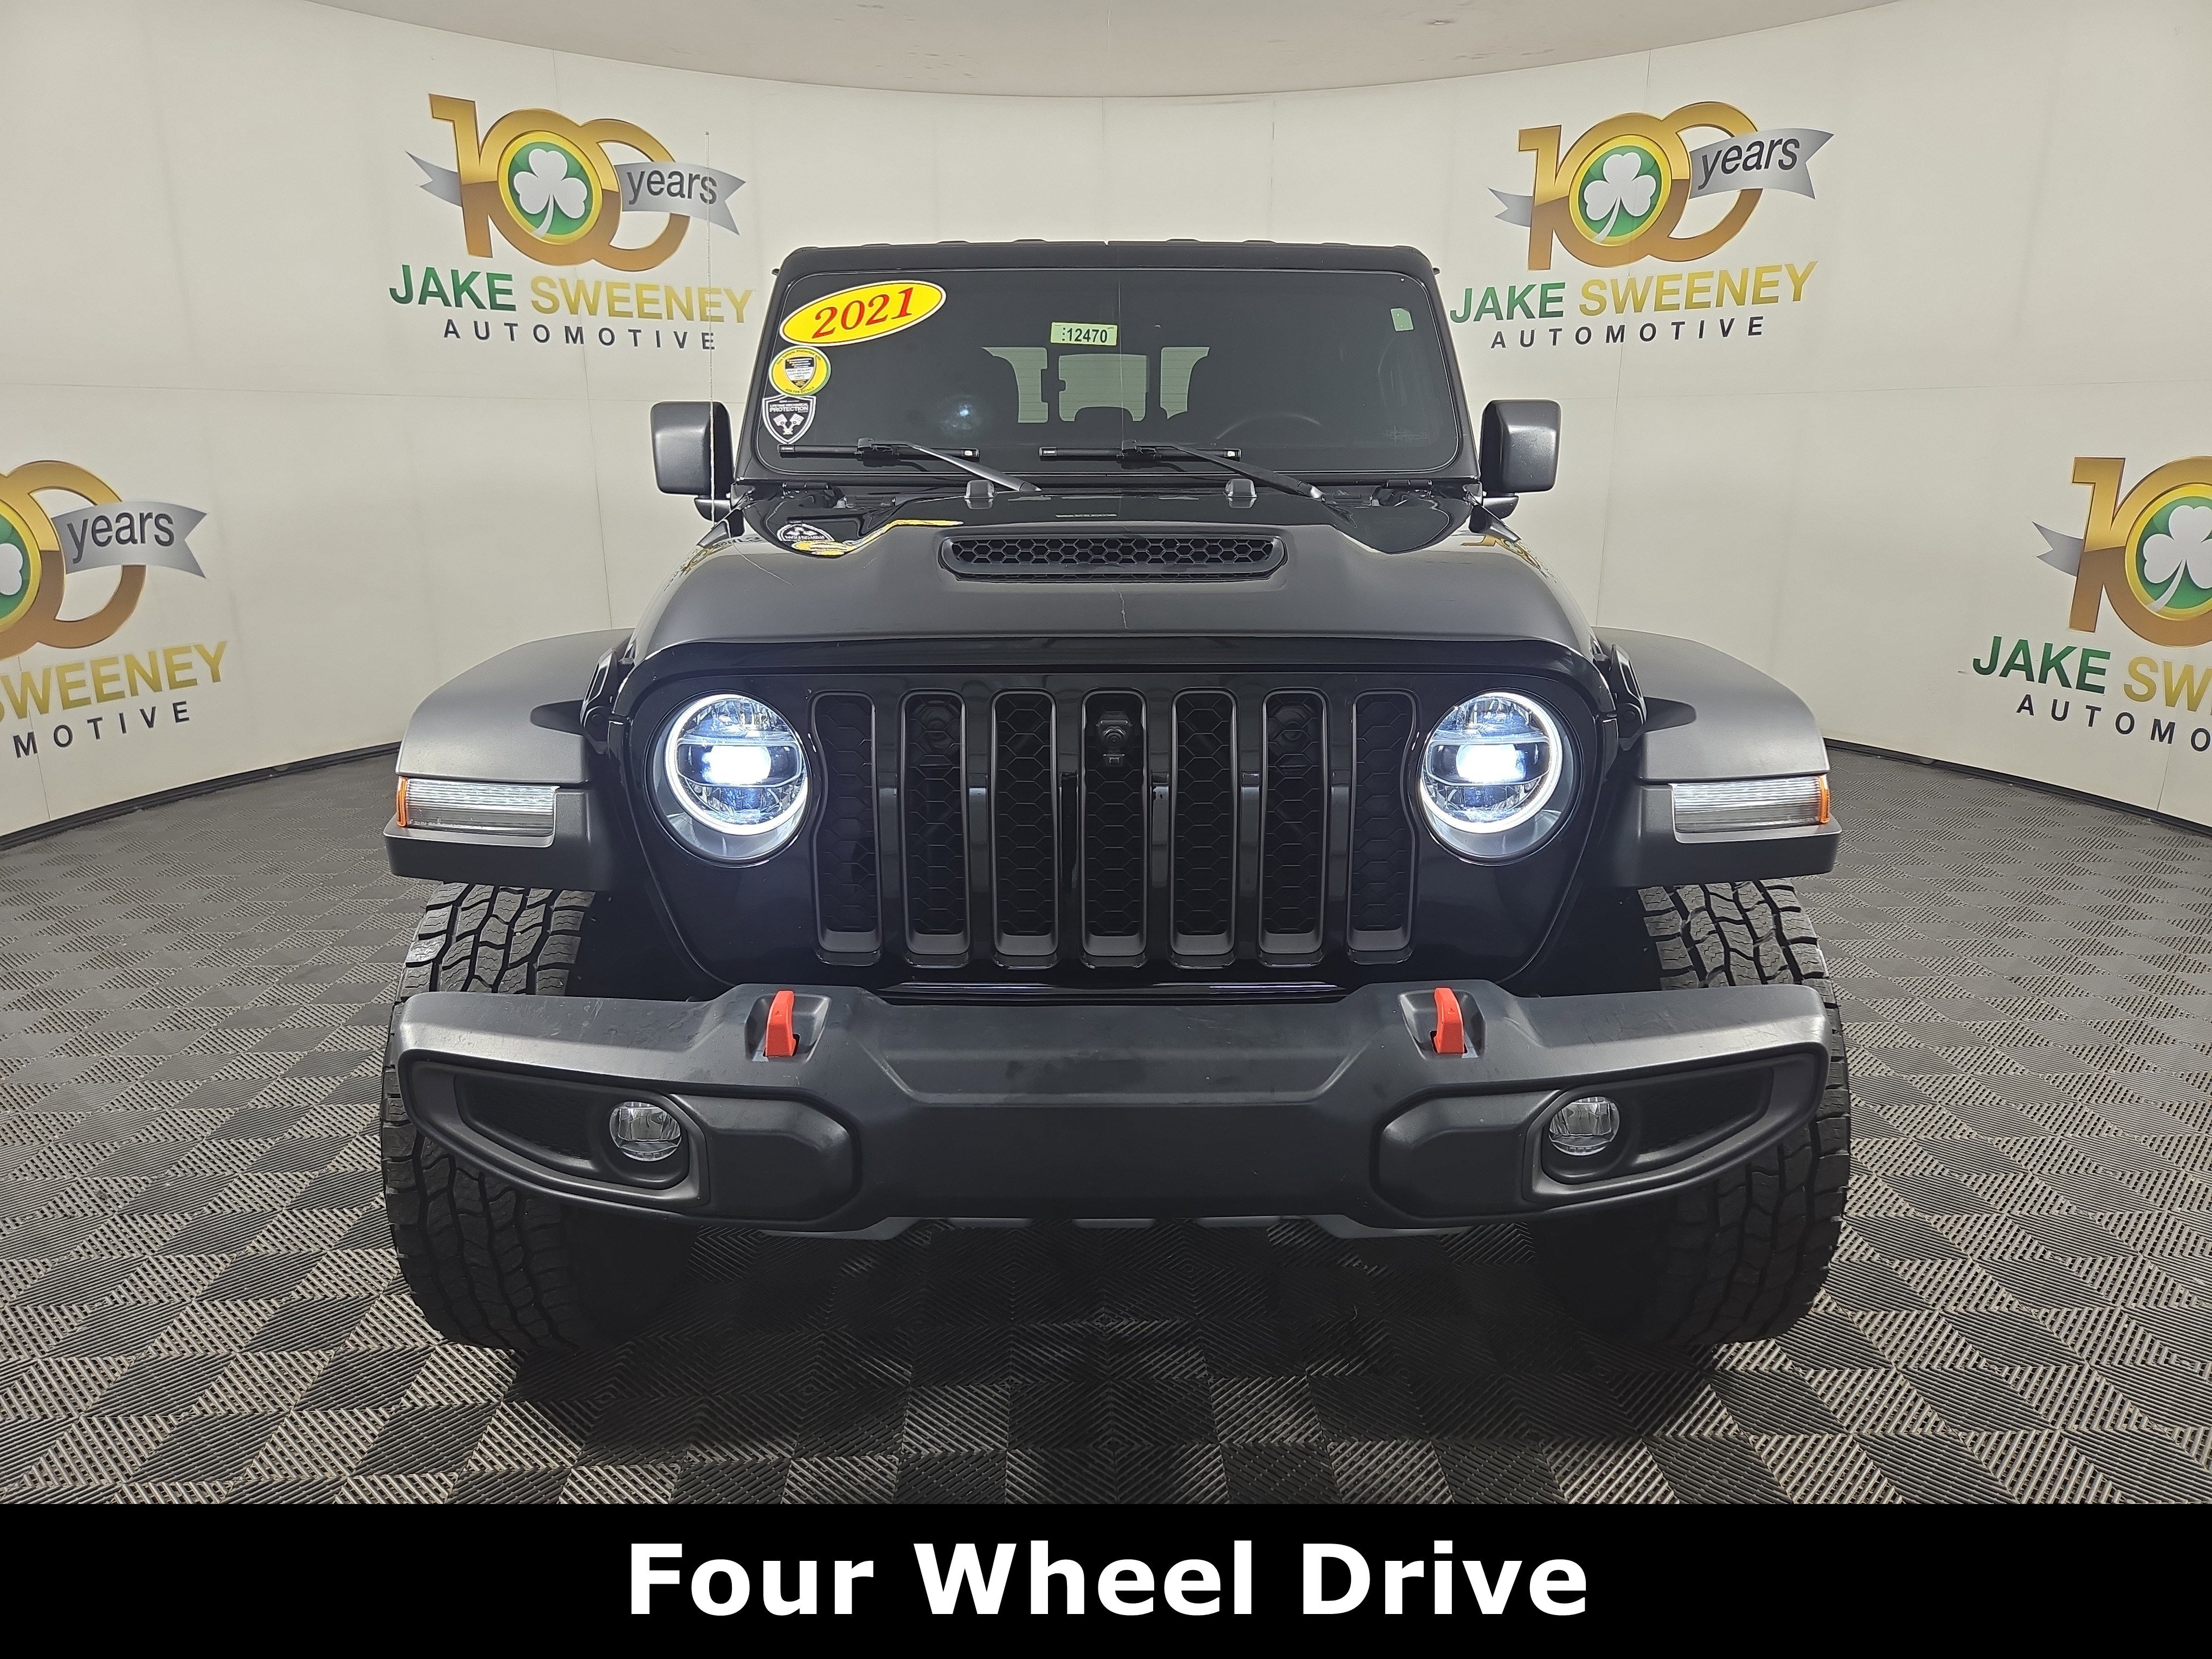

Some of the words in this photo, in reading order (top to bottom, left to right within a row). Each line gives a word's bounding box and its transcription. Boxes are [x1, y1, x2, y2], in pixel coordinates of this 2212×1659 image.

[428, 93, 690, 272] 100
[627, 169, 717, 205] years
[1517, 101, 1764, 271] 100
[1697, 137, 1800, 190] years
[389, 264, 517, 312] JAKE
[530, 275, 753, 324] SWEENEY
[812, 287, 914, 339] 2021
[1450, 281, 1566, 323] JAKE
[1579, 261, 1818, 316] SWEENEY
[443, 319, 715, 350] AUTOMOTIVE
[1490, 316, 1764, 349] AUTOMOTIVE
[67, 511, 175, 564] years
[0, 641, 228, 723] WEENEY
[1972, 636, 2111, 695] JAKE
[2124, 655, 2212, 716] SW
[13, 700, 190, 758] MOTIVE
